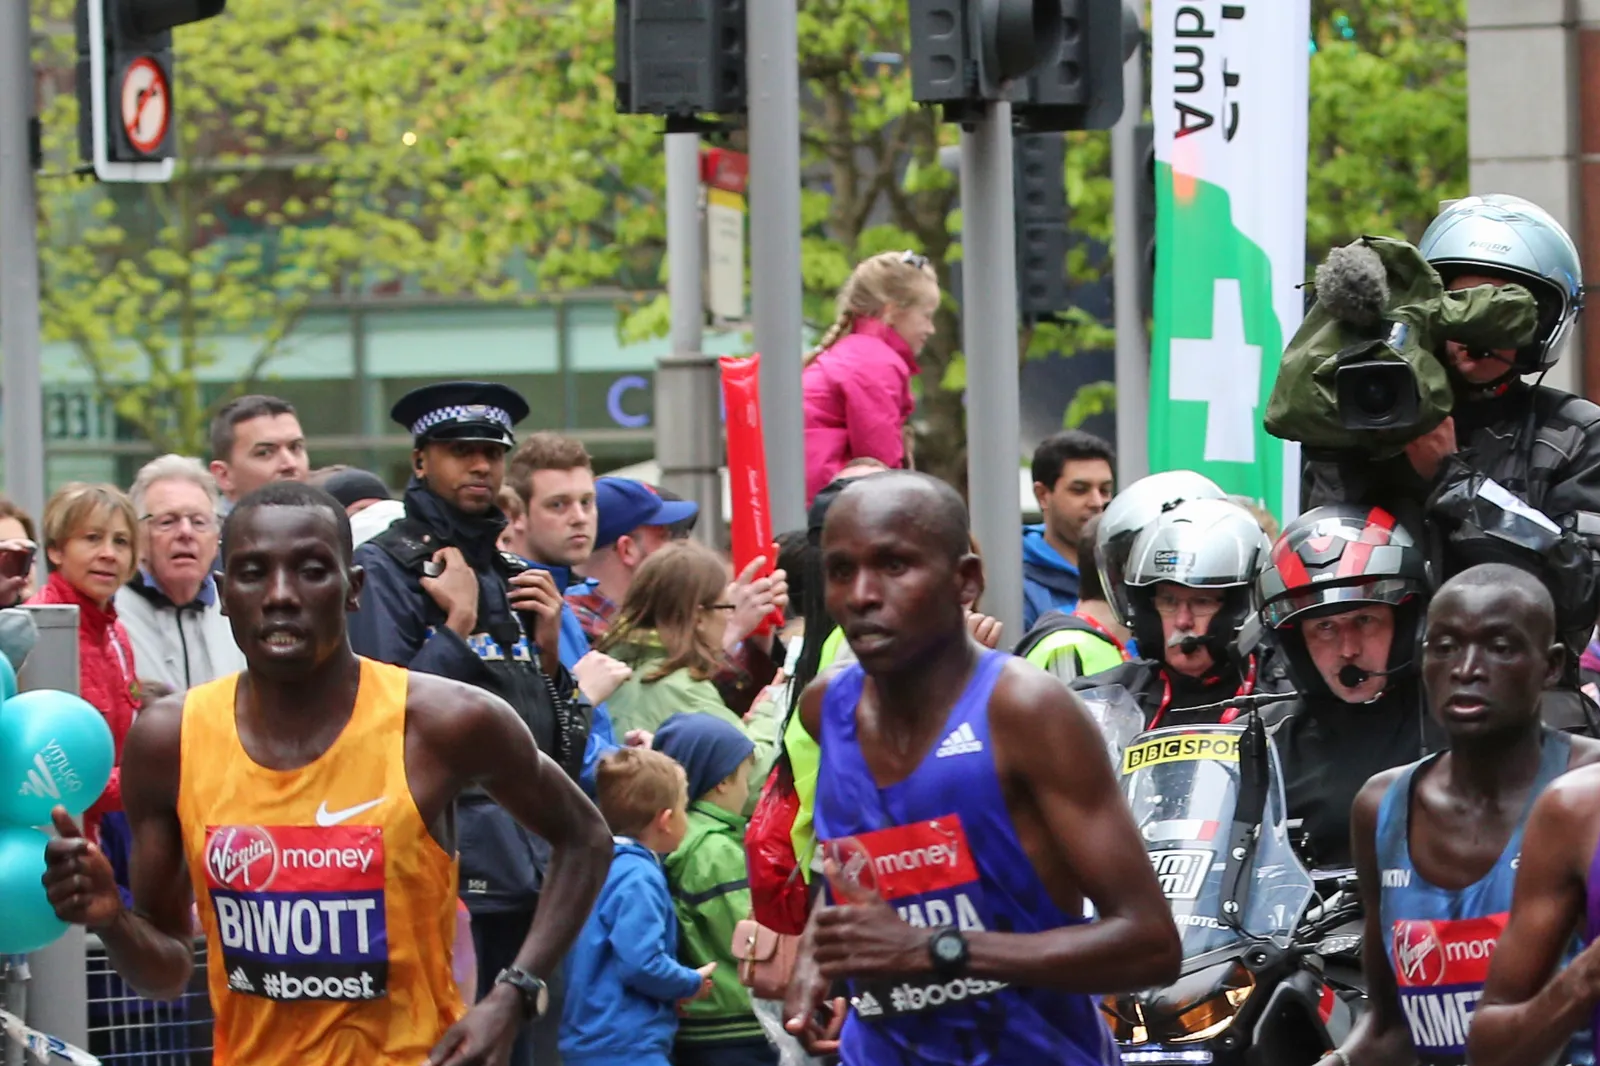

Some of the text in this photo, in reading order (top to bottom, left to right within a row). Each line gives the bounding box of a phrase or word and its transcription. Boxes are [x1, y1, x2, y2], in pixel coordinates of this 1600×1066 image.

[1128, 739, 1181, 768] BBC
[211, 828, 374, 885] Virgin money
[875, 841, 957, 874] money
[215, 896, 375, 955] BIWOTT
[1445, 939, 1498, 962] mon
[262, 971, 375, 998] #boost
[1401, 990, 1484, 1047] KIME
